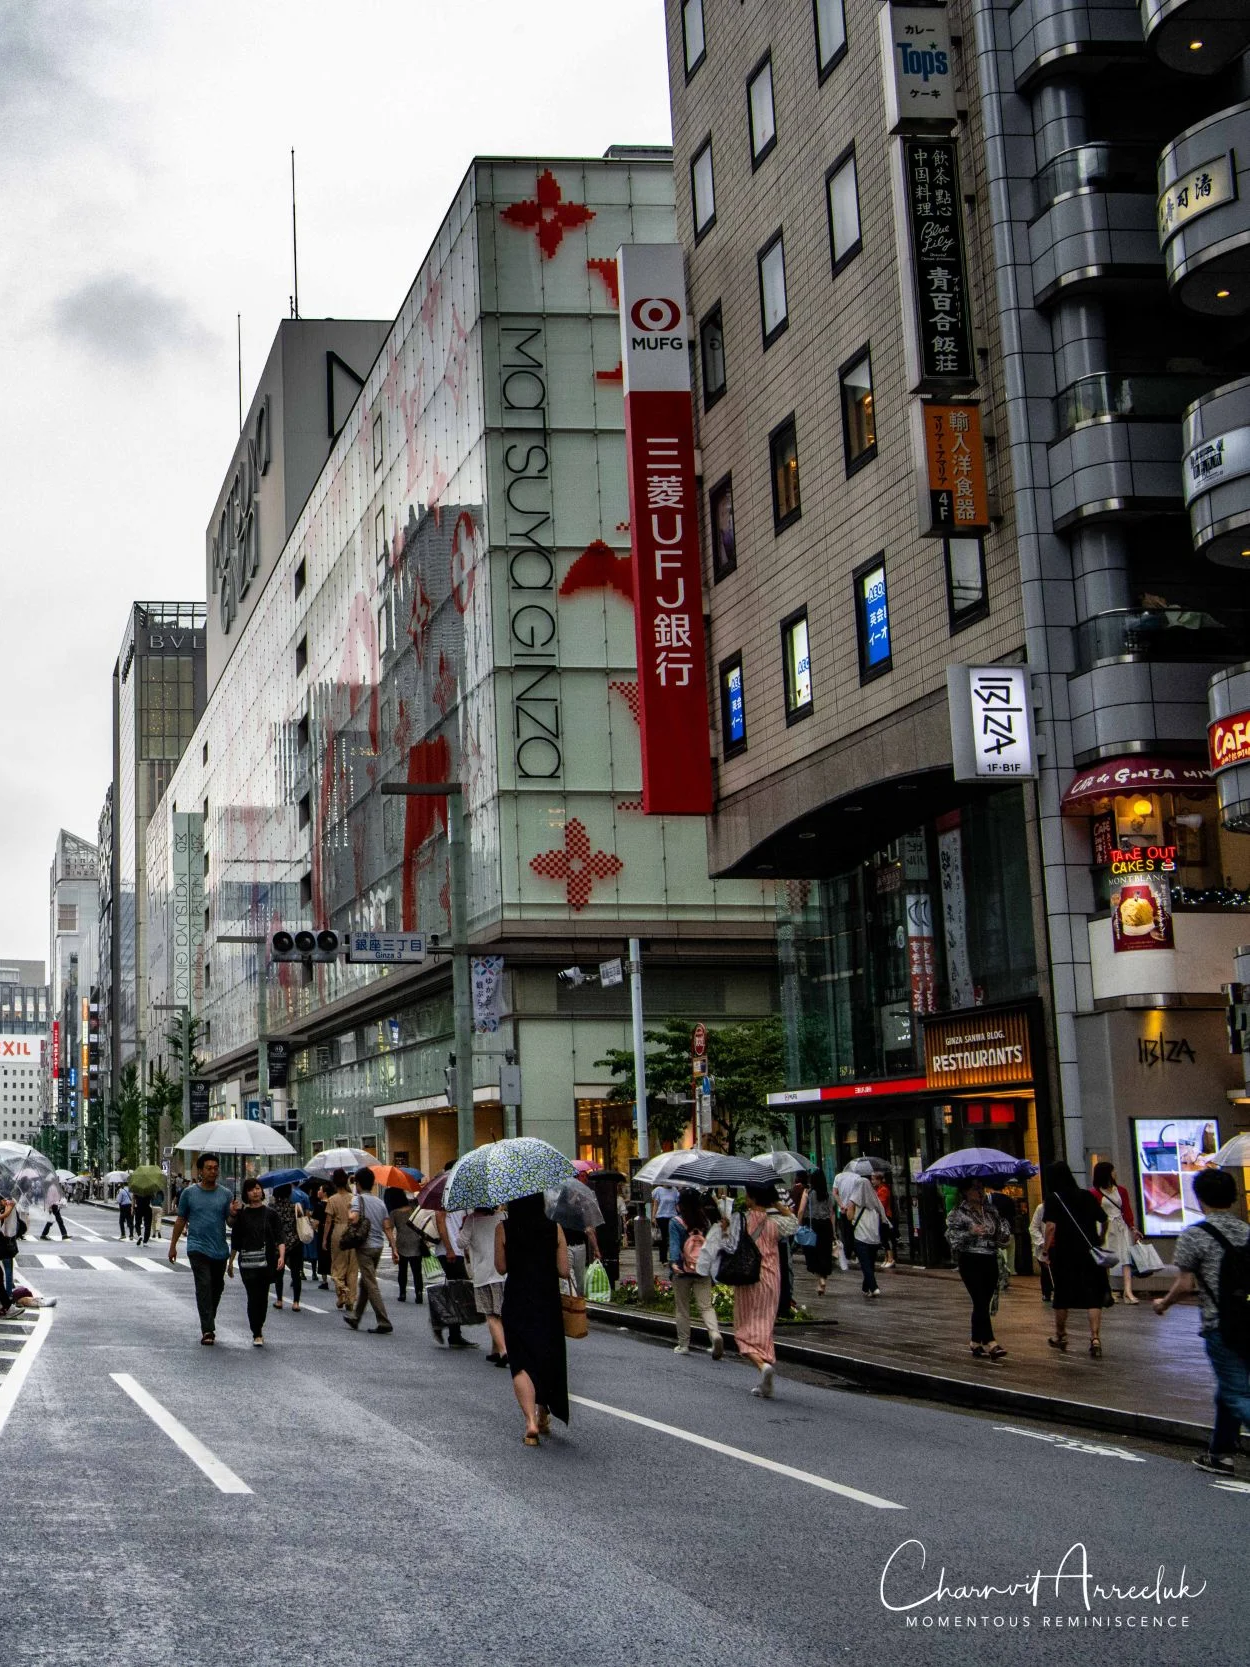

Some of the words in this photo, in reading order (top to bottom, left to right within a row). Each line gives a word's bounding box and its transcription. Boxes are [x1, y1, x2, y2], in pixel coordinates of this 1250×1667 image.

[904, 25, 935, 34] カレー
[910, 89, 941, 99] ケーキ
[914, 148, 934, 216] 中国料理
[921, 222, 949, 241] Blue
[921, 236, 955, 253] Lily
[927, 266, 958, 372] 青百合飯荘
[631, 336, 683, 351] MUFG
[950, 411, 975, 520] 輸入洋食器
[938, 492, 949, 520] 4F
[646, 437, 694, 687] 三菱UFJ銀行
[1110, 847, 1142, 862] TAKE
[1147, 846, 1176, 859] OUT
[1111, 859, 1155, 875] CAKES
[1108, 874, 1167, 885] MONTBLANC
[355, 939, 422, 951] 銀座三丁目
[945, 1037, 963, 1046] GINZA
[964, 1033, 986, 1043] SANWA
[1138, 1031, 1197, 1068] IBIZA
